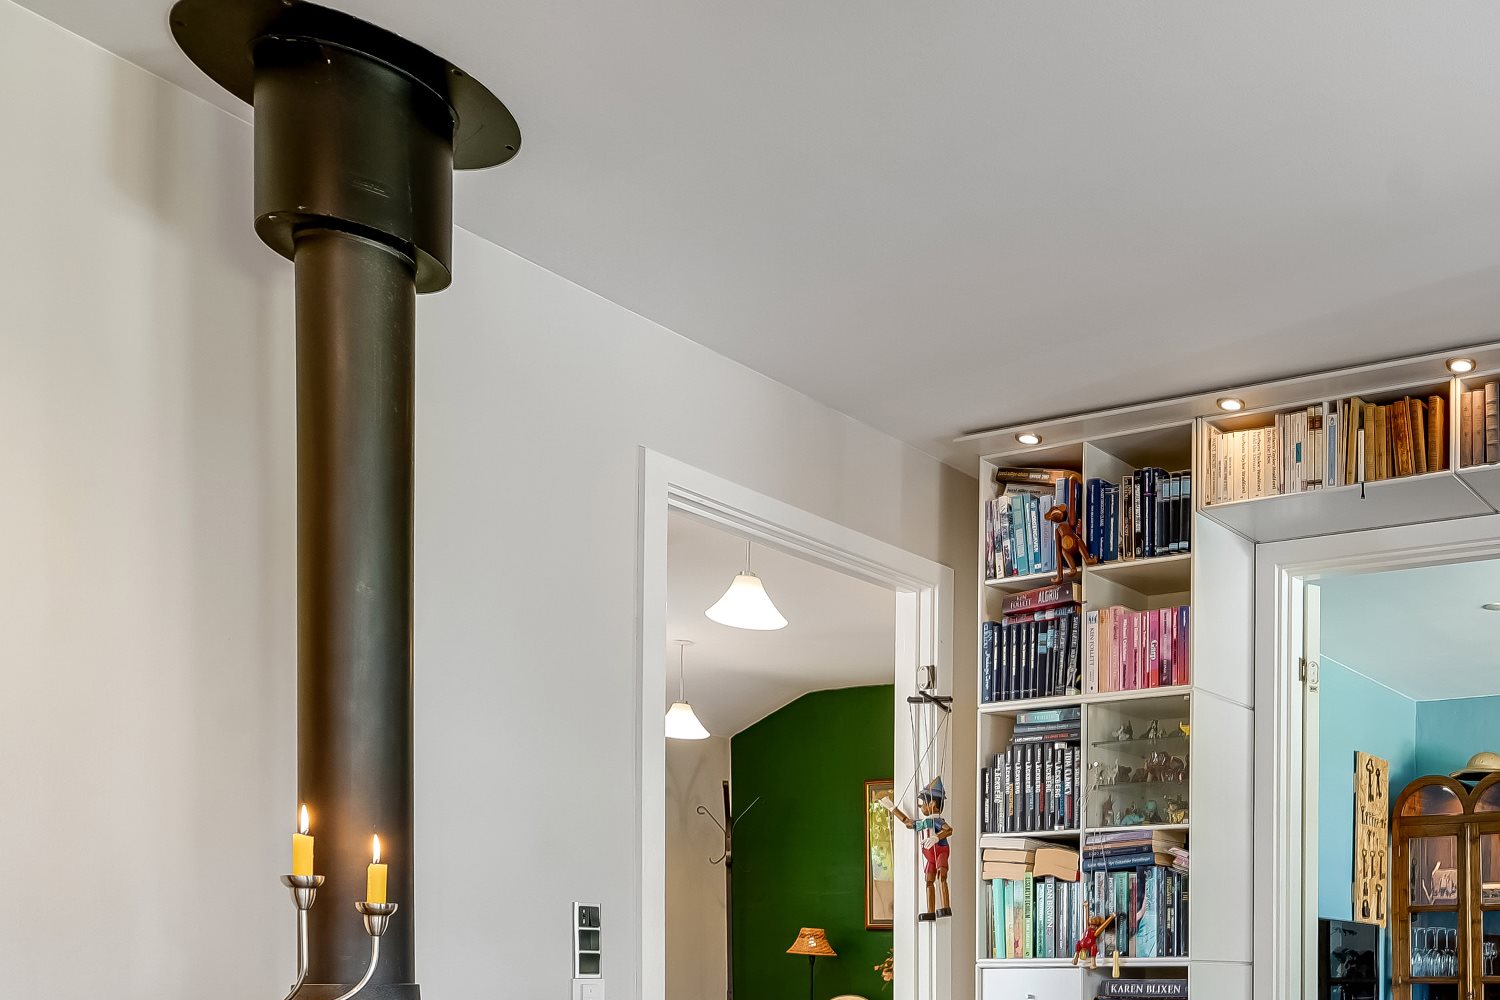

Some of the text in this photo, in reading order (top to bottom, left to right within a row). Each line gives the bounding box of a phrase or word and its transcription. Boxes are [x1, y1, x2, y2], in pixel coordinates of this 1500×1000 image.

[1150, 640, 1158, 660] Garp
[994, 768, 1002, 803] LÄCKBERG
[1046, 884, 1054, 928] DAN BROWN
[1111, 984, 1180, 994] KAREN BLIXEN
